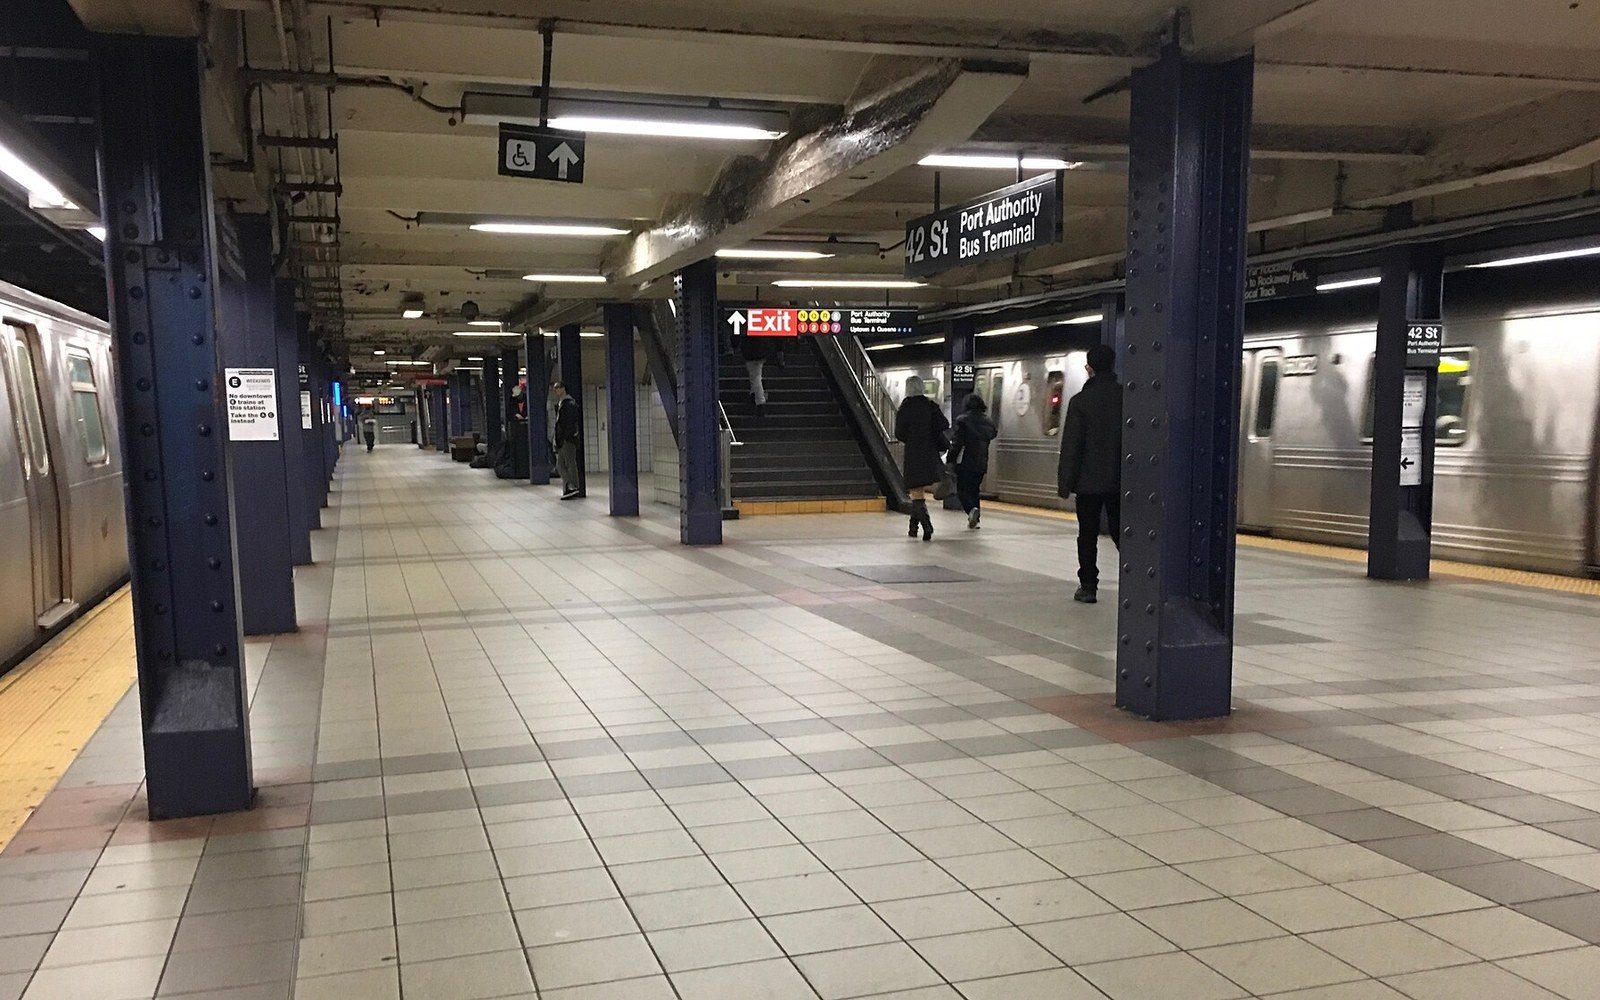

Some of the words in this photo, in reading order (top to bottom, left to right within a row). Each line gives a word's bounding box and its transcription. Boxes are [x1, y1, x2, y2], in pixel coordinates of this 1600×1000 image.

[960, 207, 983, 233] Port
[986, 191, 1042, 226] Authority
[906, 226, 924, 263] 42
[930, 220, 948, 258] St
[960, 237, 980, 259] Bus
[983, 218, 1035, 252] Terminal
[748, 310, 791, 332] Exit
[1408, 327, 1422, 338] 42
[1425, 327, 1438, 339] St
